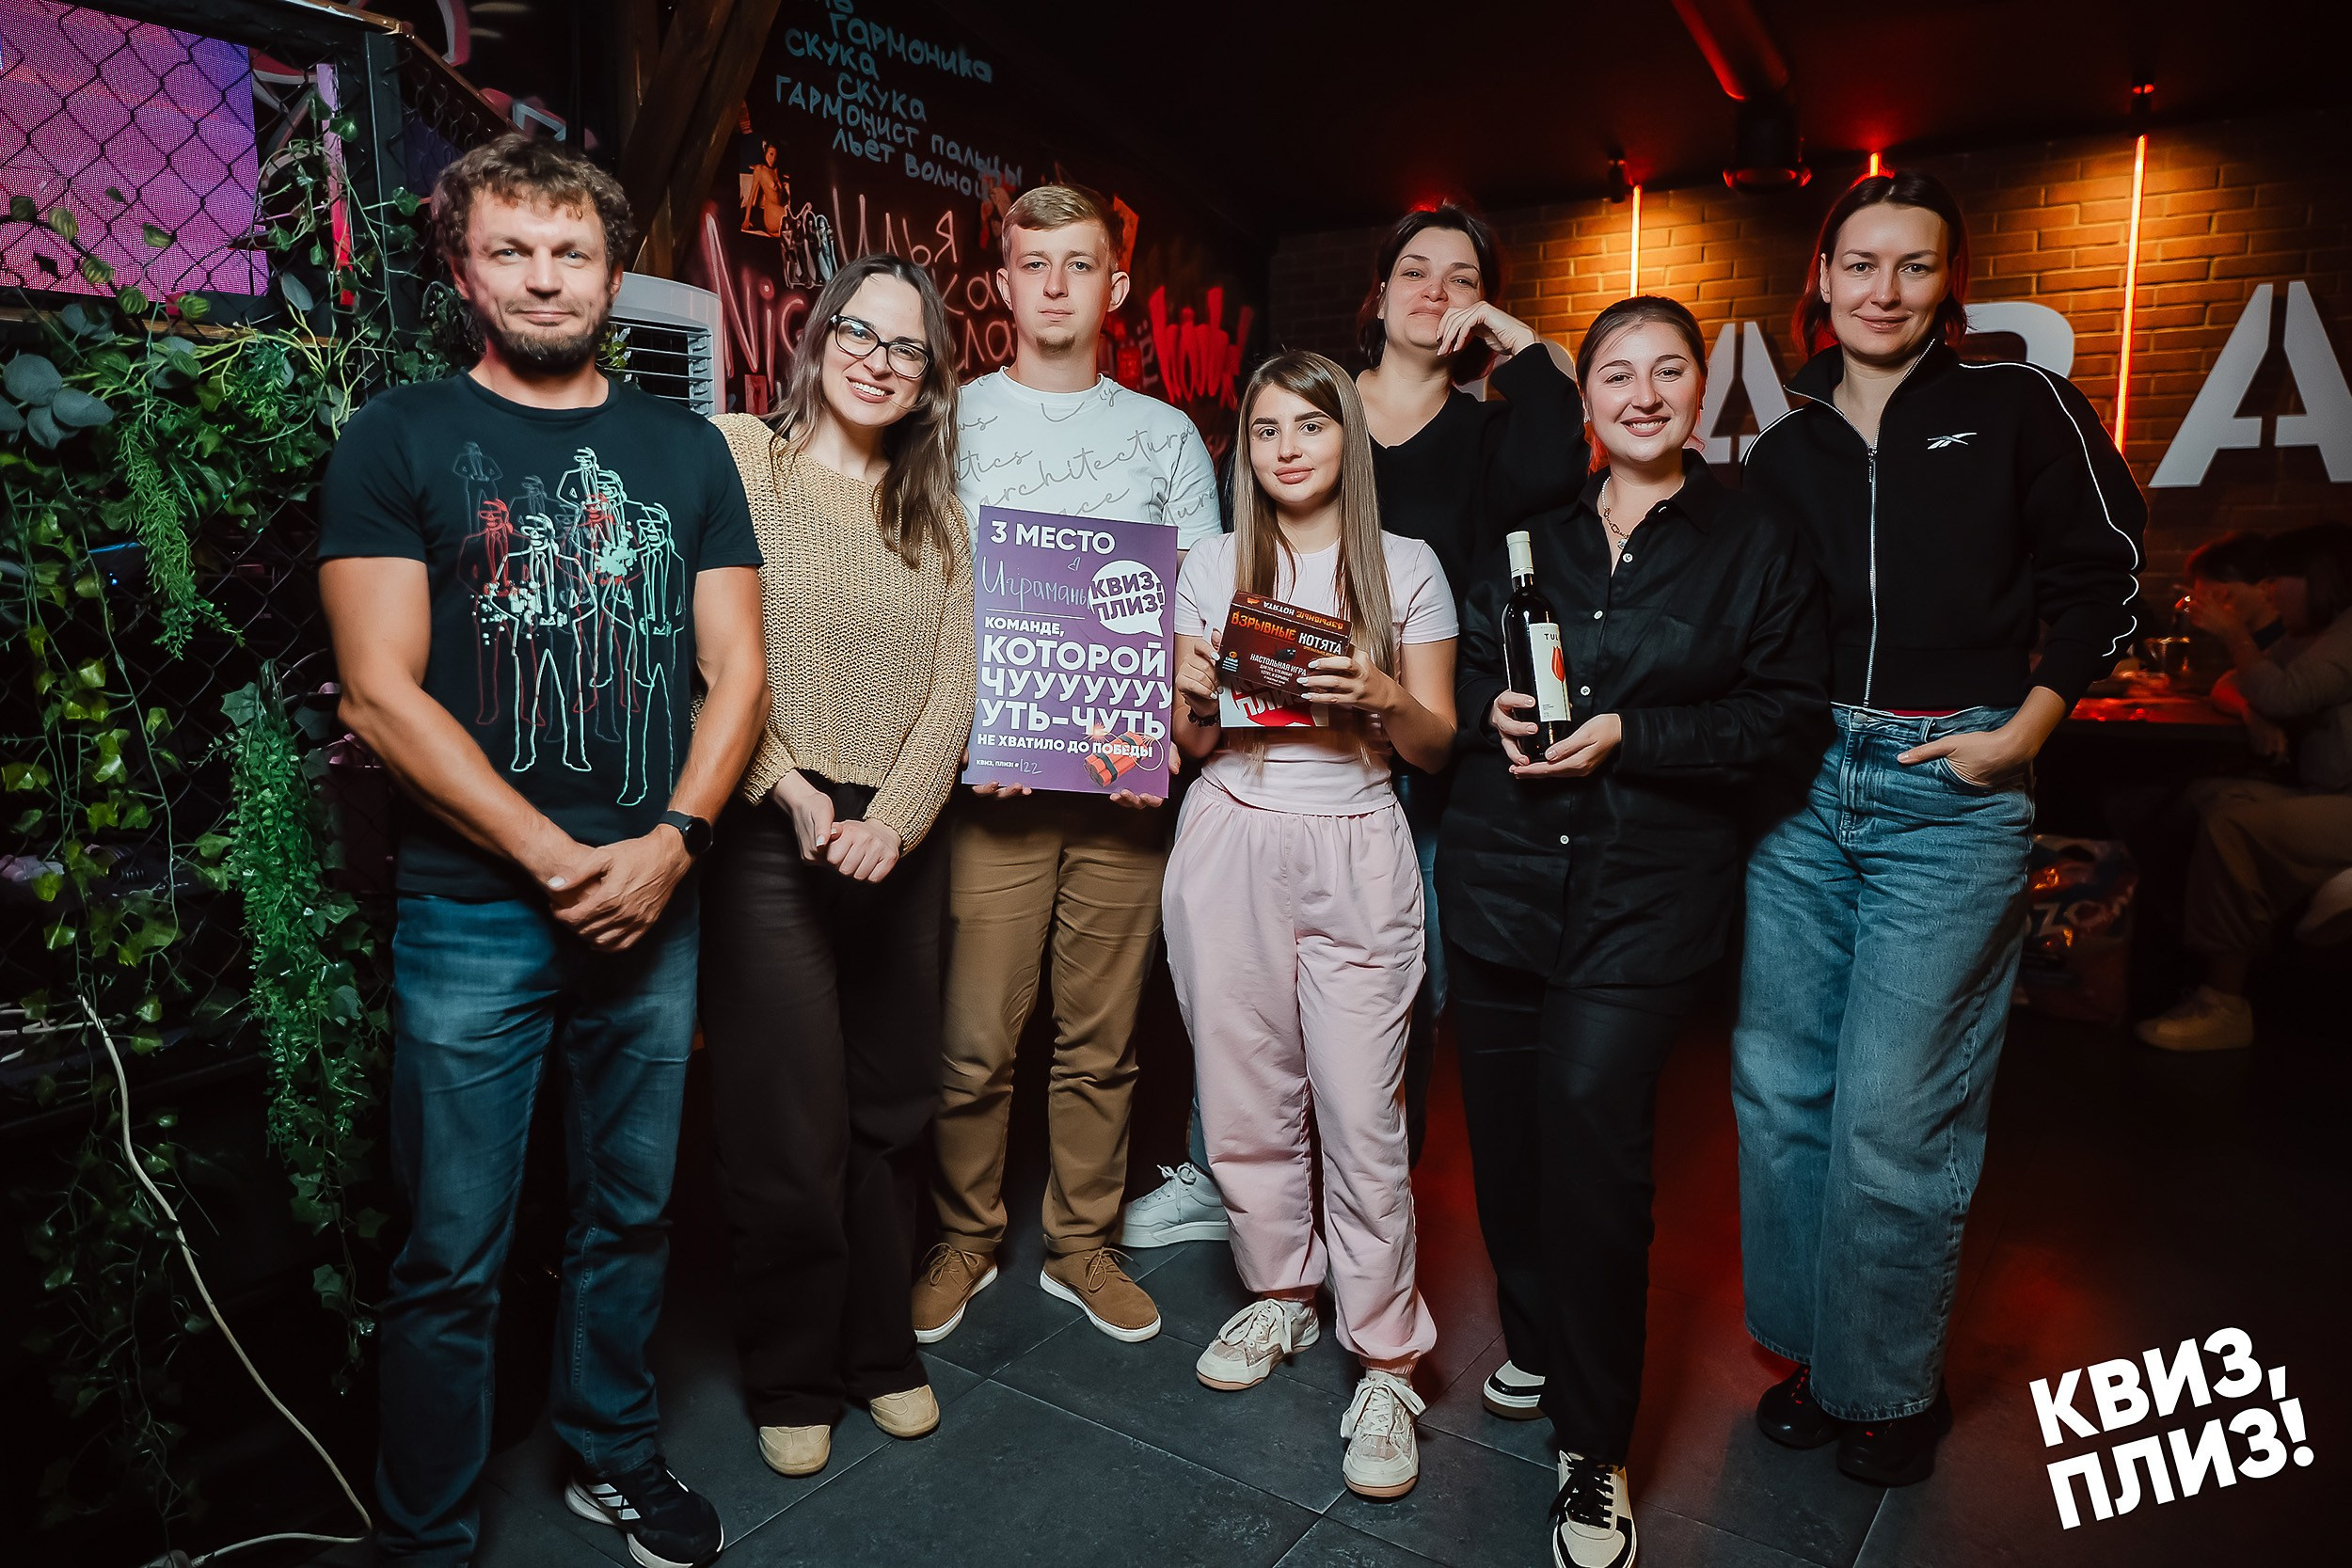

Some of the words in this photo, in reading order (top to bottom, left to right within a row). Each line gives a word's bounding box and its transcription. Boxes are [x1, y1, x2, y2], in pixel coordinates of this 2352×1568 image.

[990, 520, 1008, 544] 3
[1015, 523, 1116, 555] МЕСТО
[1090, 571, 1163, 599] КВИЗ,
[1090, 593, 1165, 622] ПЛИЗ!
[1263, 600, 1295, 617] КОТЯТА
[984, 616, 1065, 638] КОМАНДЕ,
[1231, 610, 1297, 641] ВЗРЫВНЫЕ
[1298, 632, 1343, 656] КОТЯТА
[982, 634, 1167, 678] КОТОРОЙ
[1249, 653, 1292, 672] НАСТОЛЬНАЯ
[1290, 663, 1307, 676] ИГРА
[1235, 689, 1307, 717] ПЛИ
[977, 733, 996, 746] НЕ
[998, 735, 1066, 752] ХВАТИЛО
[1067, 741, 1089, 754] ДО
[1092, 742, 1153, 759] ПОБЕДЫ
